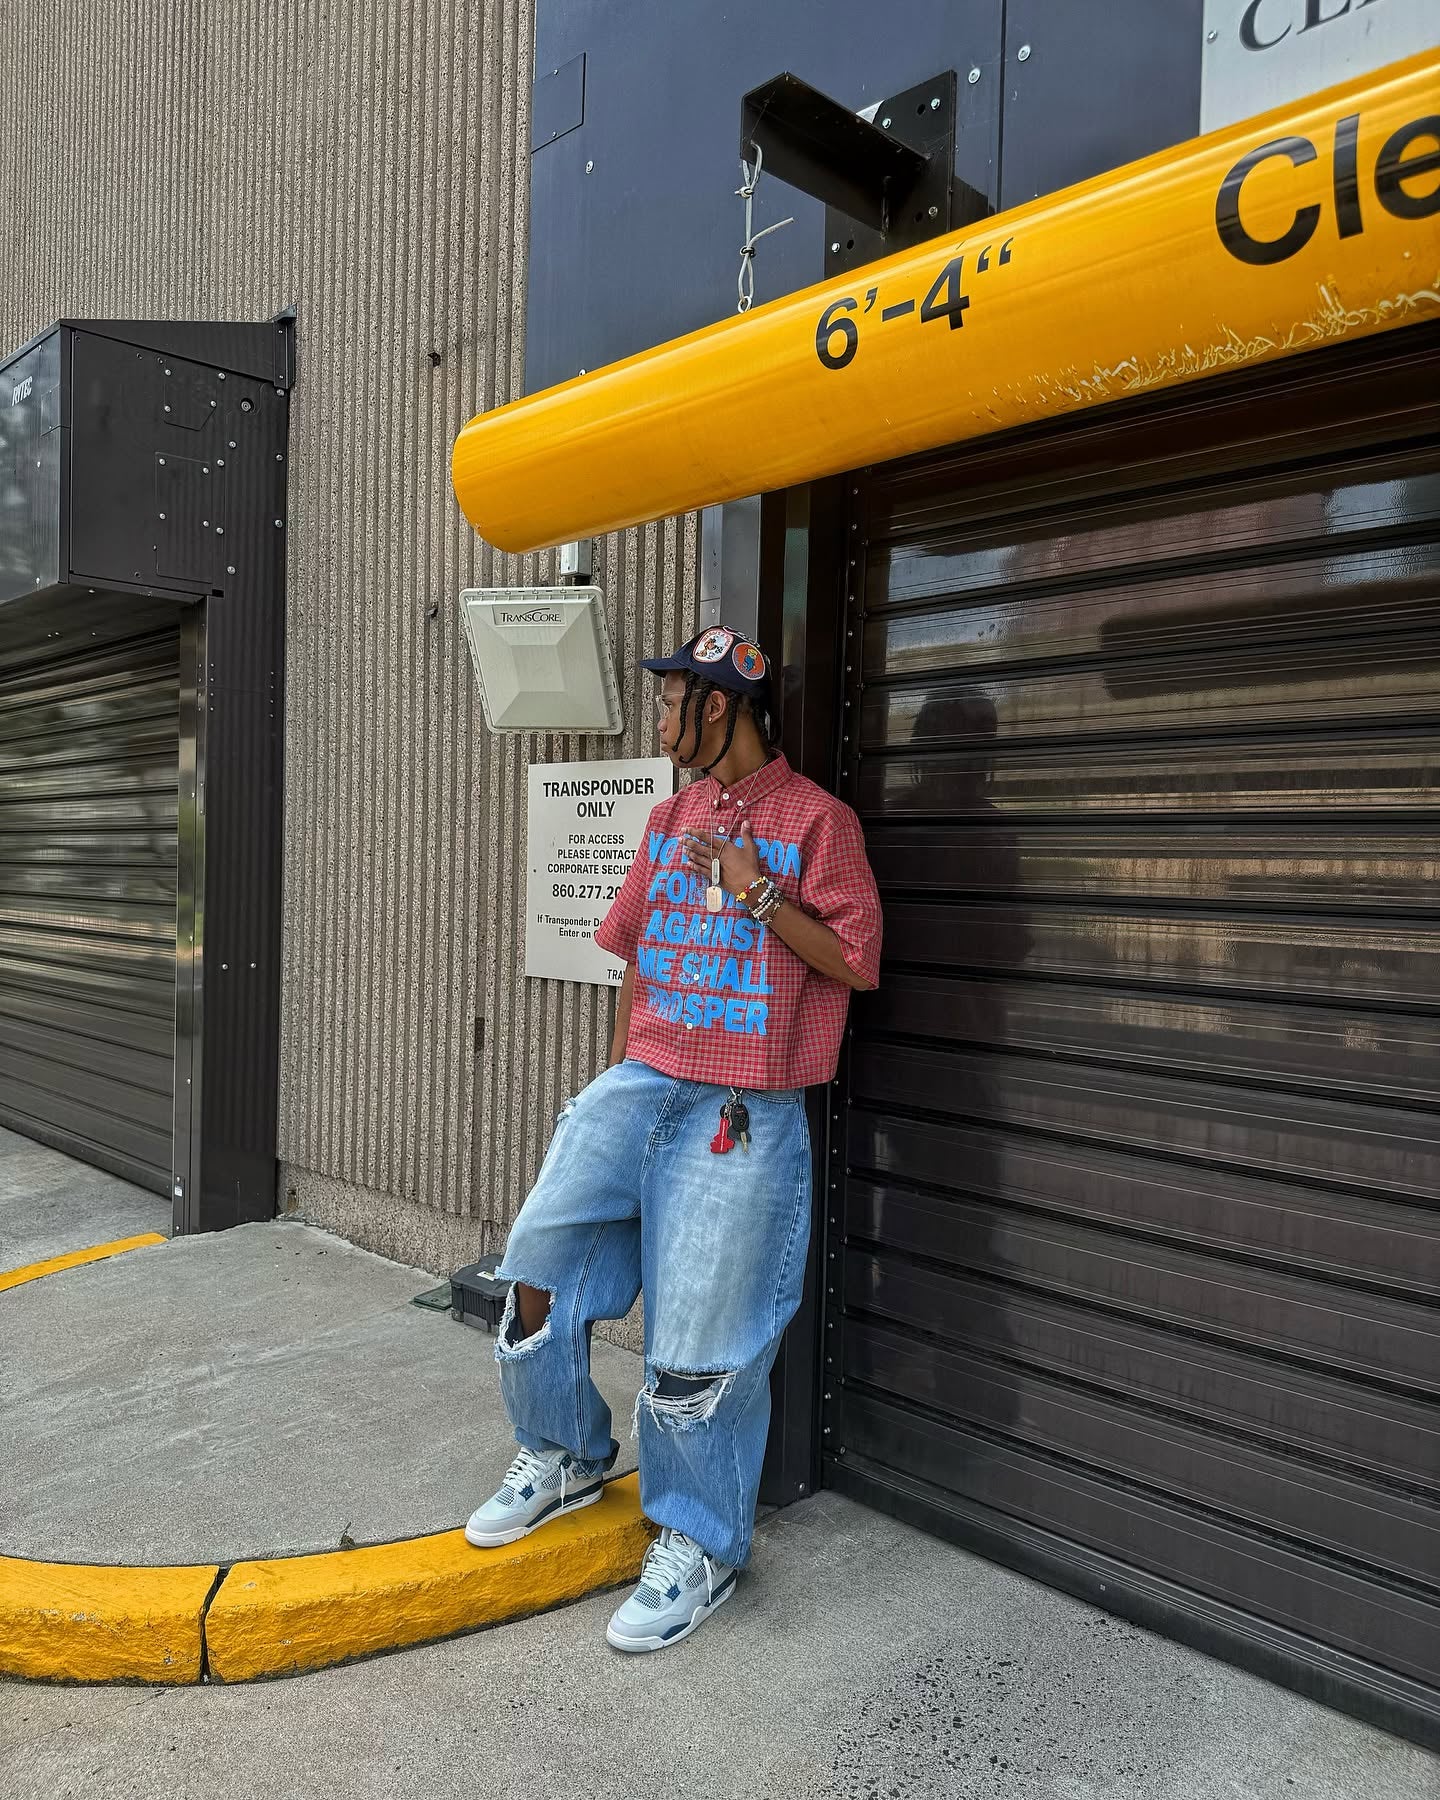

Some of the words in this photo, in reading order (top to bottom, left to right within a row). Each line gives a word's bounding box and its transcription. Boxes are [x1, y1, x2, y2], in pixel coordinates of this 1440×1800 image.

[543, 778, 654, 798] TRANSPONDER
[577, 801, 615, 817] ONLY
[568, 835, 586, 845] FOR
[588, 834, 624, 845] ACCESS
[557, 849, 590, 860] PLEASE
[592, 849, 637, 860] CONTACT
[548, 864, 599, 874] CORPORATE
[537, 914, 543, 924] If
[545, 914, 591, 927] Transponder
[559, 927, 579, 938] Enter
[581, 931, 591, 939] on
[645, 910, 765, 953] AGAINST
[607, 968, 625, 981] TRA
[638, 945, 677, 984] ME
[679, 952, 773, 994] SHALL
[646, 985, 768, 1036] PROSPER
